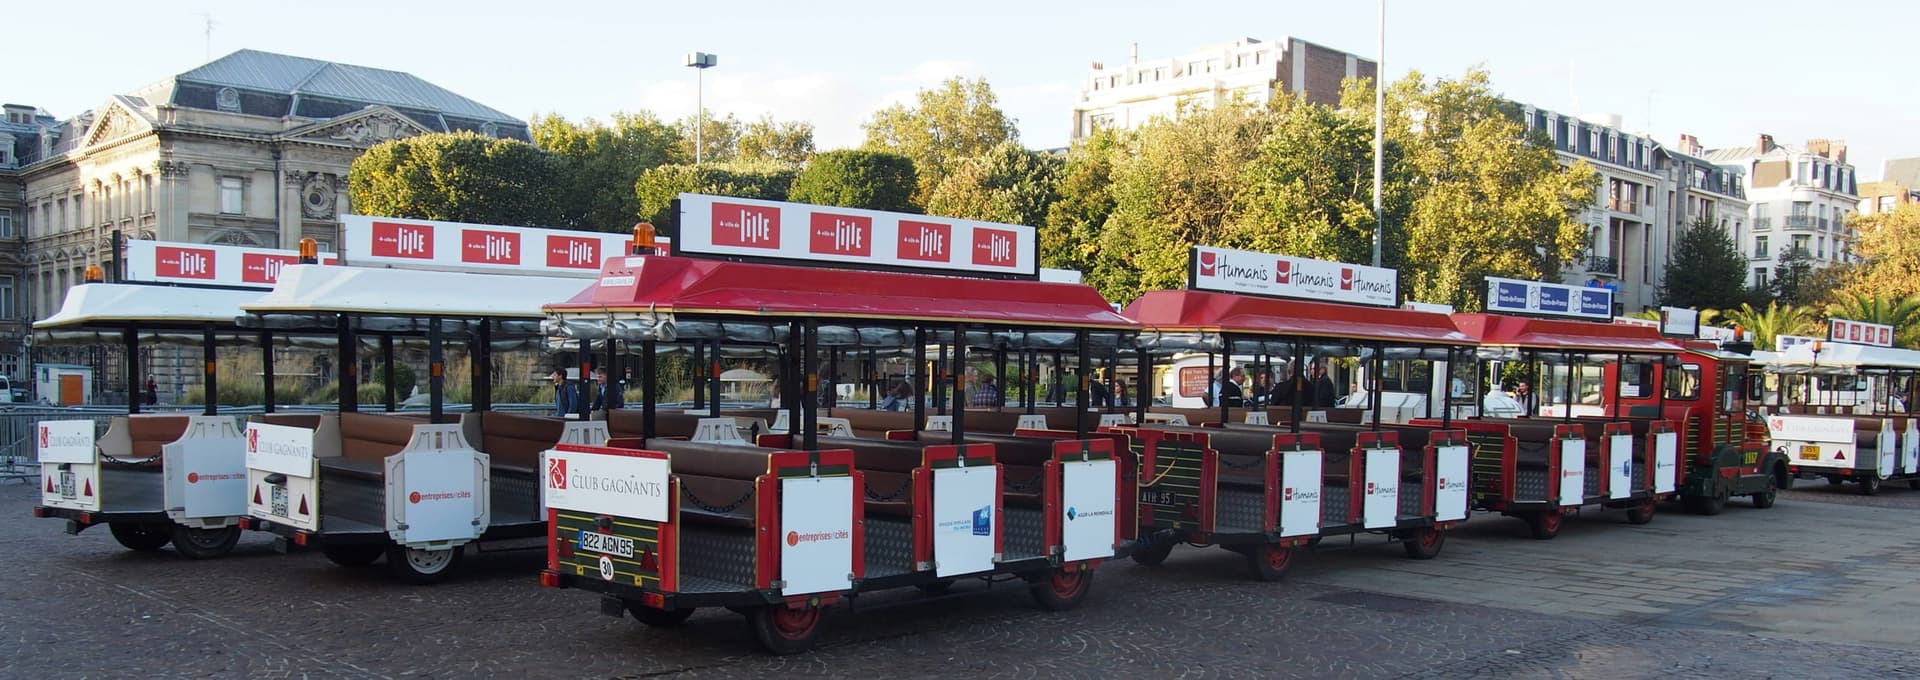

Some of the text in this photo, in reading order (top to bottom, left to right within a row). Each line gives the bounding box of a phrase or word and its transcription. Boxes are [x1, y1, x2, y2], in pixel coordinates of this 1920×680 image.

[1218, 254, 1268, 281] Humanis
[1291, 263, 1334, 288] Humanis
[1353, 270, 1392, 294] Humanis
[421, 492, 454, 501] entreprises
[572, 475, 661, 497] CLUB GAGNANTS
[584, 533, 632, 555] 822 AGN 95
[800, 532, 832, 543] entreprises
[602, 561, 612, 576] 30
